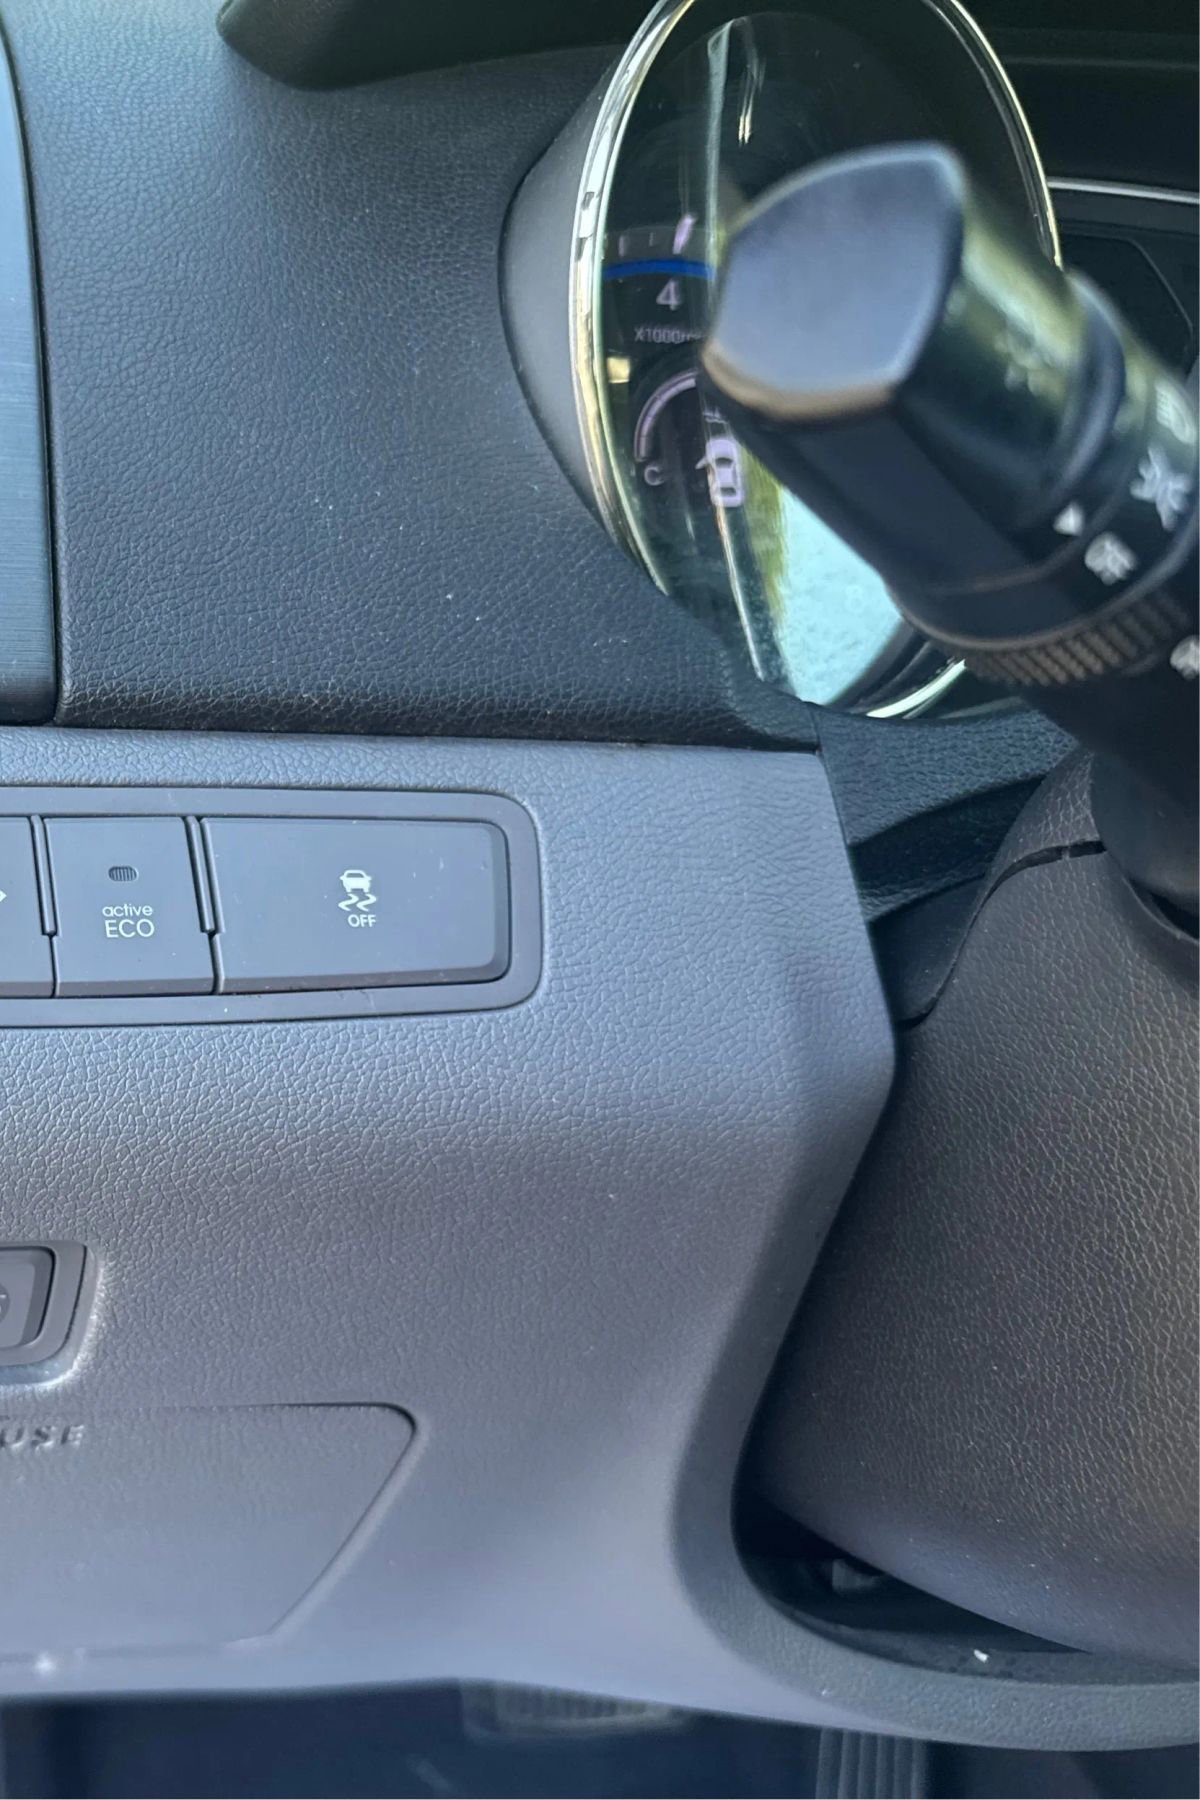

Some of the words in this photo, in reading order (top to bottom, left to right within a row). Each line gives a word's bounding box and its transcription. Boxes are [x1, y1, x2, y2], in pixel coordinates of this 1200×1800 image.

[656, 279, 680, 311] 4
[644, 466, 664, 486] C
[102, 903, 153, 917] active
[104, 918, 155, 939] ECO
[347, 914, 377, 928] OFF
